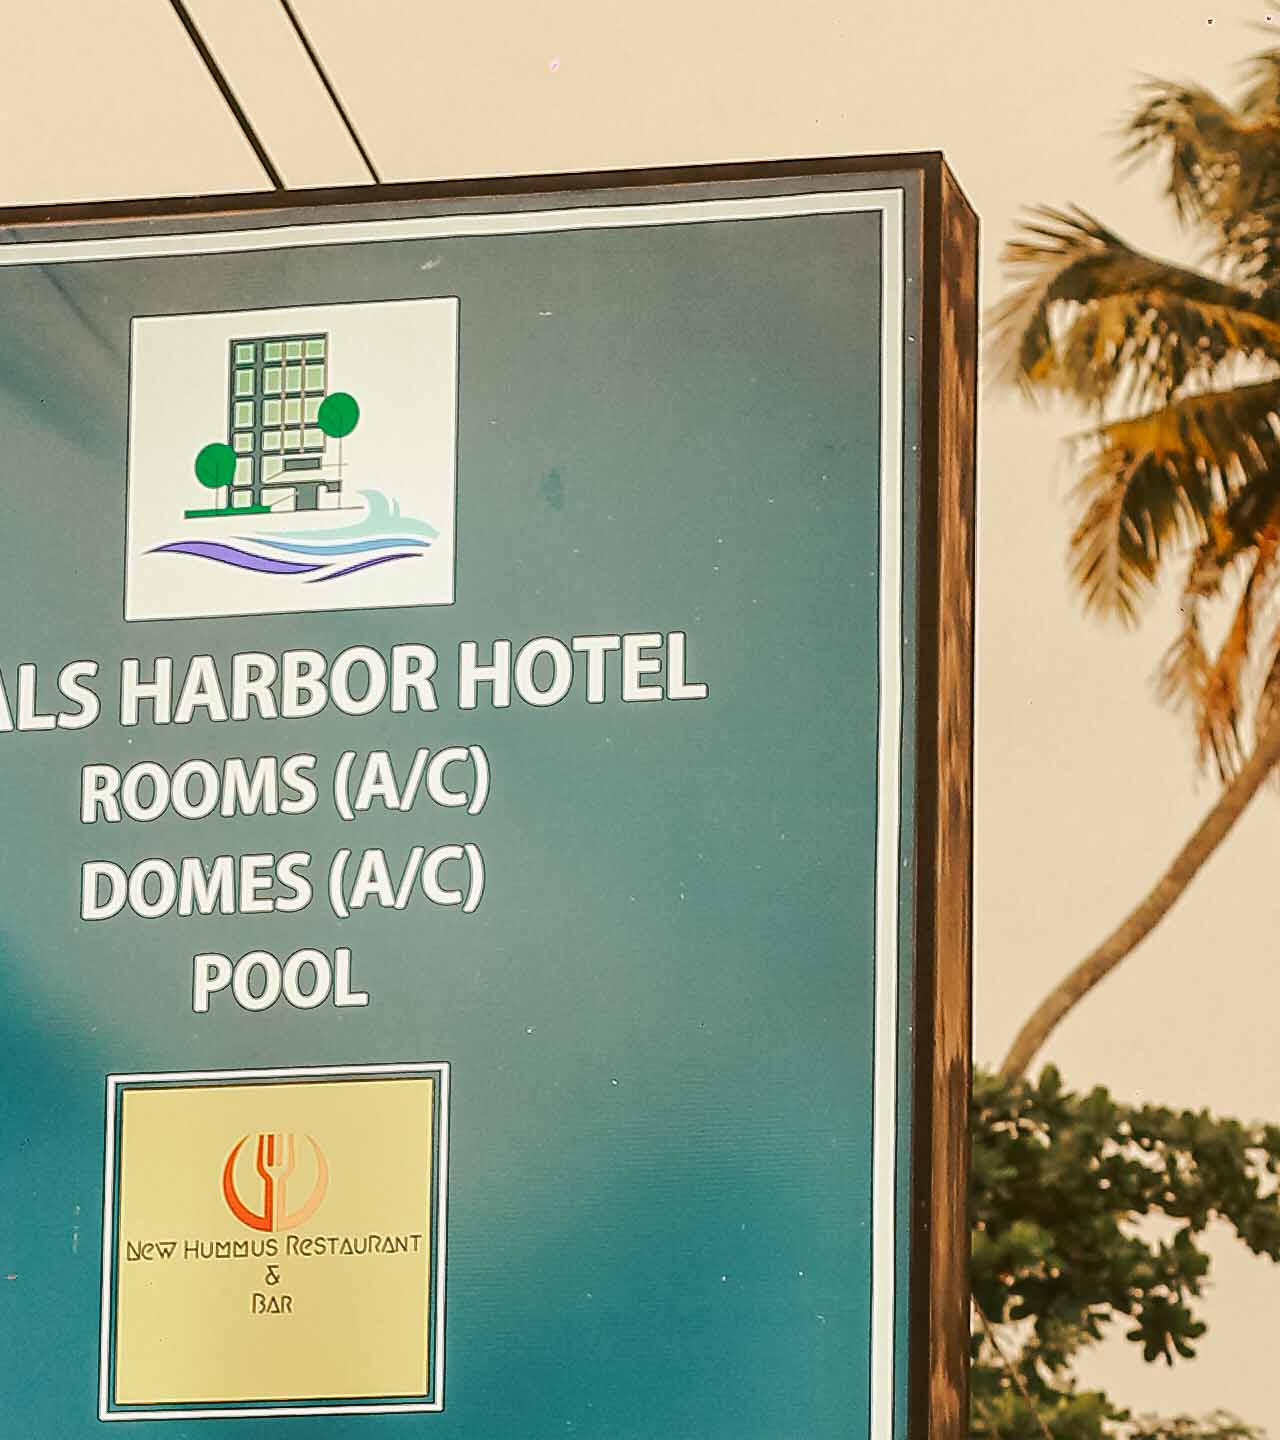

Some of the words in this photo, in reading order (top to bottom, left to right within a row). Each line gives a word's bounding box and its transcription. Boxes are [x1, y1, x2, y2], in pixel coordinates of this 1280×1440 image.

[122, 646, 437, 725] HARBOR
[460, 633, 706, 708] HOTEL
[82, 755, 316, 822] ROOMS
[335, 747, 488, 819] (A/C)
[82, 853, 311, 919] DOMES
[330, 844, 483, 917] (A/C)
[194, 950, 368, 1011] POOL
[265, 1265, 280, 1285] &
